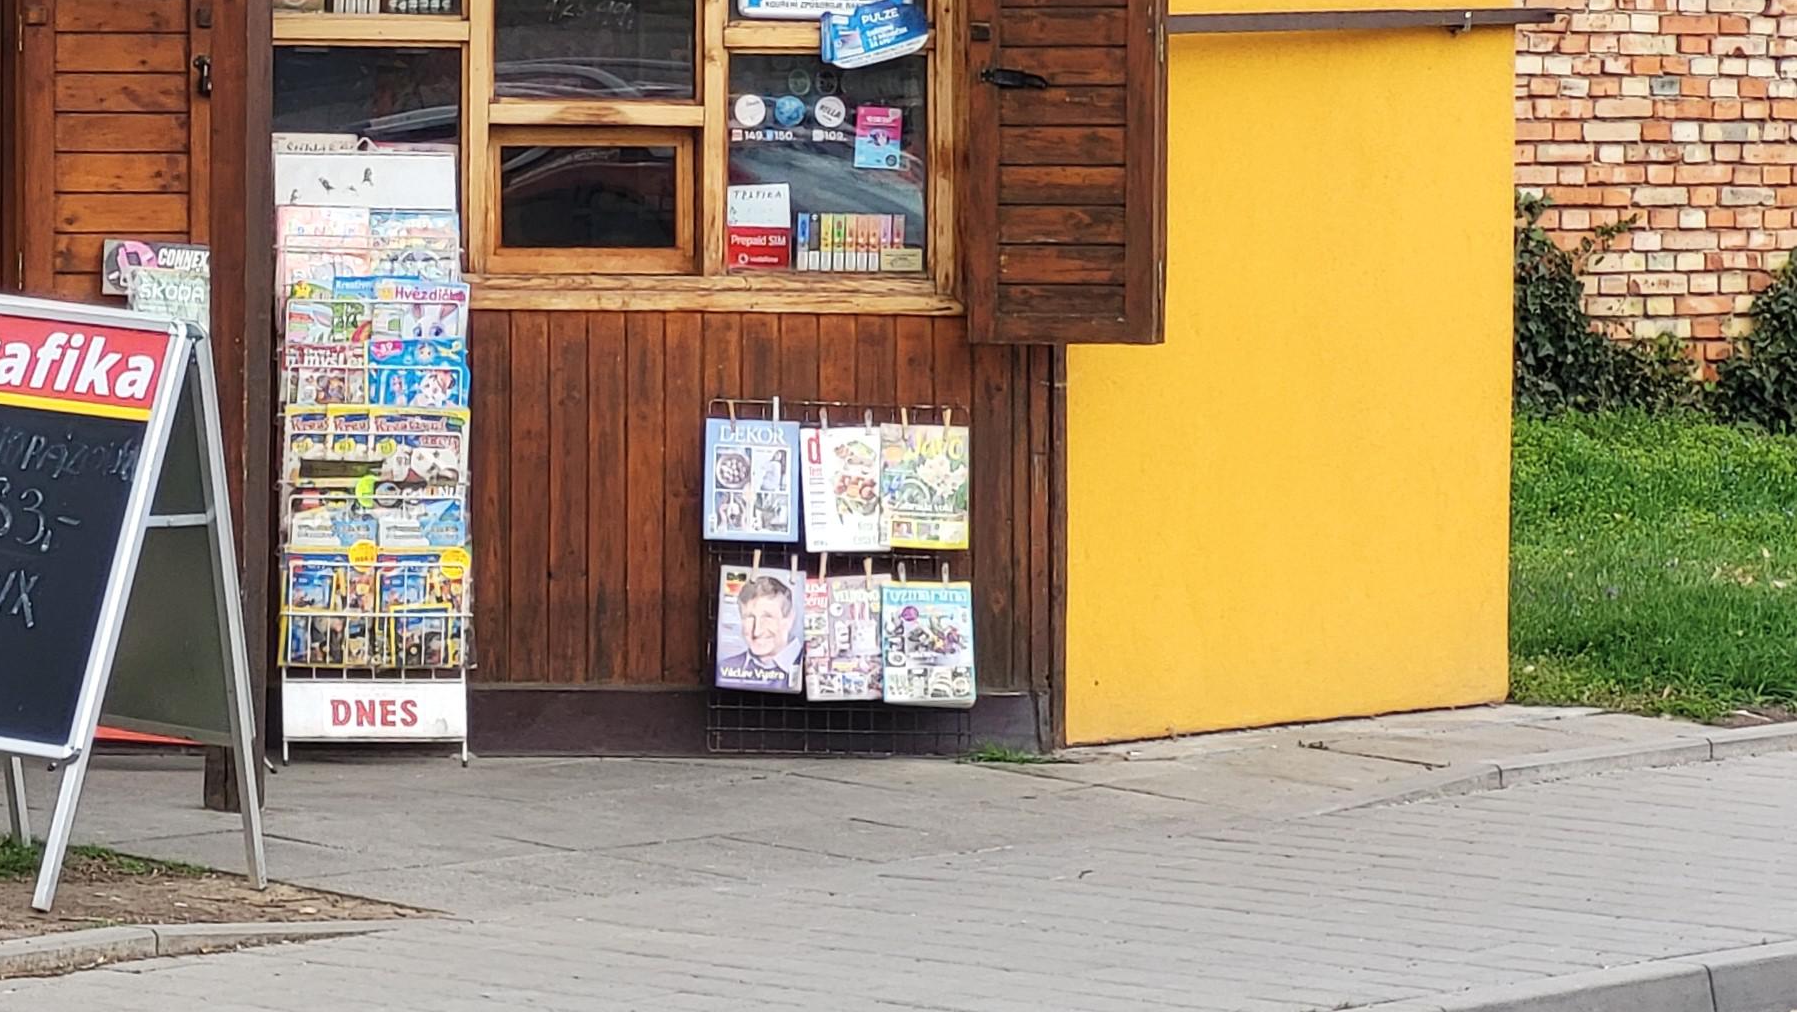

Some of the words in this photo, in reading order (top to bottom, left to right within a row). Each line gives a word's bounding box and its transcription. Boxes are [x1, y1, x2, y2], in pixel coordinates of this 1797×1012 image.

[861, 7, 899, 24] PULZE
[730, 234, 767, 247] Prepaid
[768, 235, 786, 246] SIM
[720, 425, 786, 445] DEKOR
[807, 428, 821, 465] d
[330, 699, 418, 727] DNES
